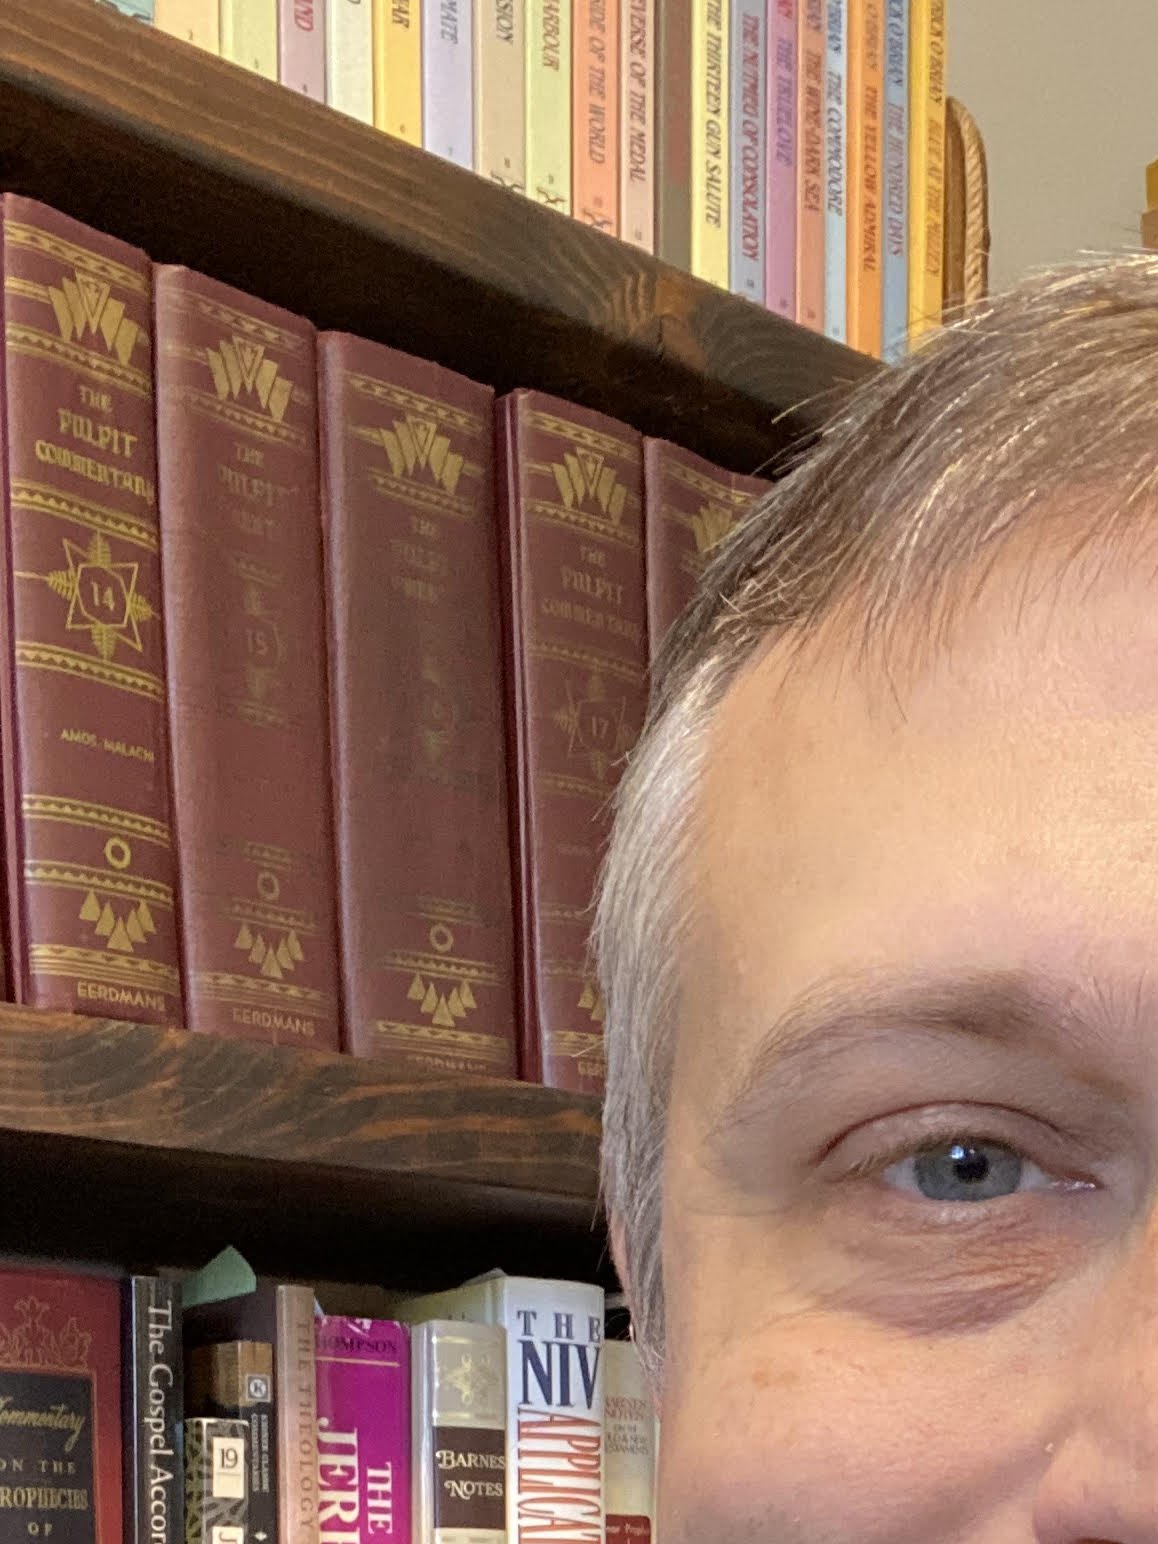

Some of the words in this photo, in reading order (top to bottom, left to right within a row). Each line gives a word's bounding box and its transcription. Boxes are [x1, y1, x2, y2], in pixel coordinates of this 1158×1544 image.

[742, 13, 760, 48] THE
[705, 32, 722, 114] THIRTEEN
[588, 104, 606, 164] WORLD
[629, 126, 647, 183] MEDAL
[705, 119, 722, 157] GUN
[742, 120, 760, 144] OF
[827, 107, 843, 216] COMMODORE
[705, 160, 722, 228] SALUTE
[742, 145, 760, 261] CONSOLATION
[79, 385, 112, 413] THE
[57, 408, 138, 459] PULPIT
[91, 581, 116, 611] 14
[76, 981, 166, 1013] EERDMANS
[232, 1007, 316, 1038] EERDMANS
[147, 1298, 173, 1355] The
[298, 1319, 311, 1367] THE
[517, 1309, 600, 1343] THE
[517, 1338, 601, 1410] NIV
[144, 1363, 174, 1456] Gospel
[219, 1447, 239, 1470] 19
[299, 1385, 313, 1528] THEOLOGY
[435, 1449, 505, 1470] BARNES
[366, 1461, 393, 1535] THE
[443, 1479, 504, 1500] NOTES
[27, 1520, 53, 1537] OF
